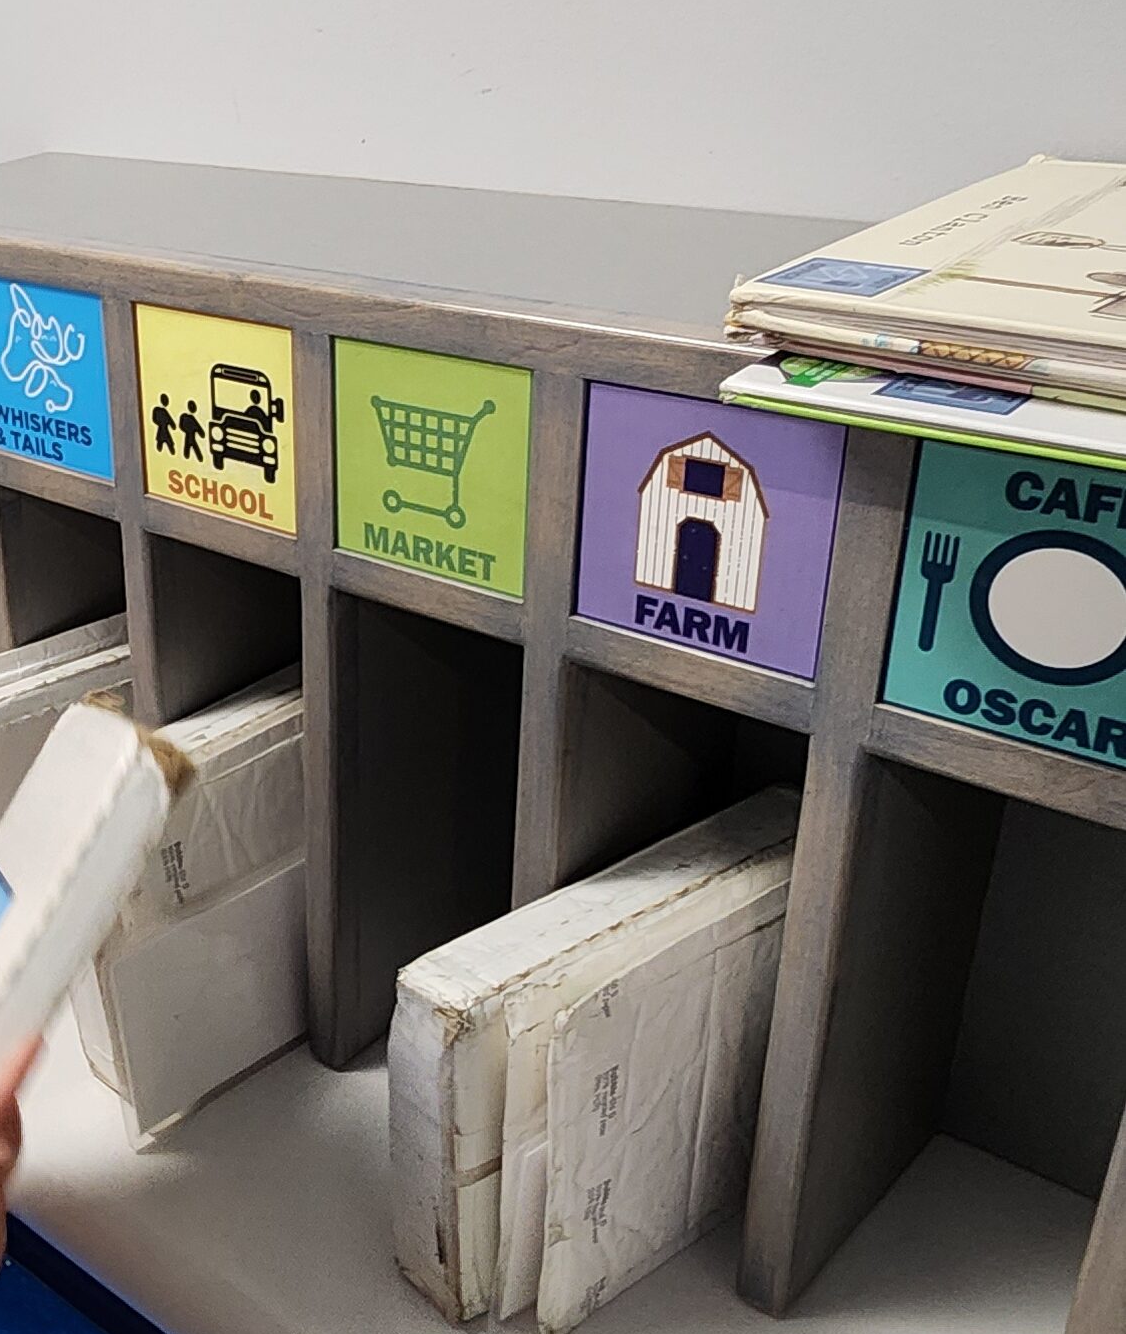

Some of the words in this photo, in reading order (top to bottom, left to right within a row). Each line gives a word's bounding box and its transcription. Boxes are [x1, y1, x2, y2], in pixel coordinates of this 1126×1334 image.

[9, 428, 63, 463] TAILS
[168, 469, 274, 521] SCHOOL
[1005, 471, 1126, 530] CAF
[363, 523, 496, 582] MARKET
[634, 594, 750, 654] FARM
[943, 678, 1126, 759] OSCAR
